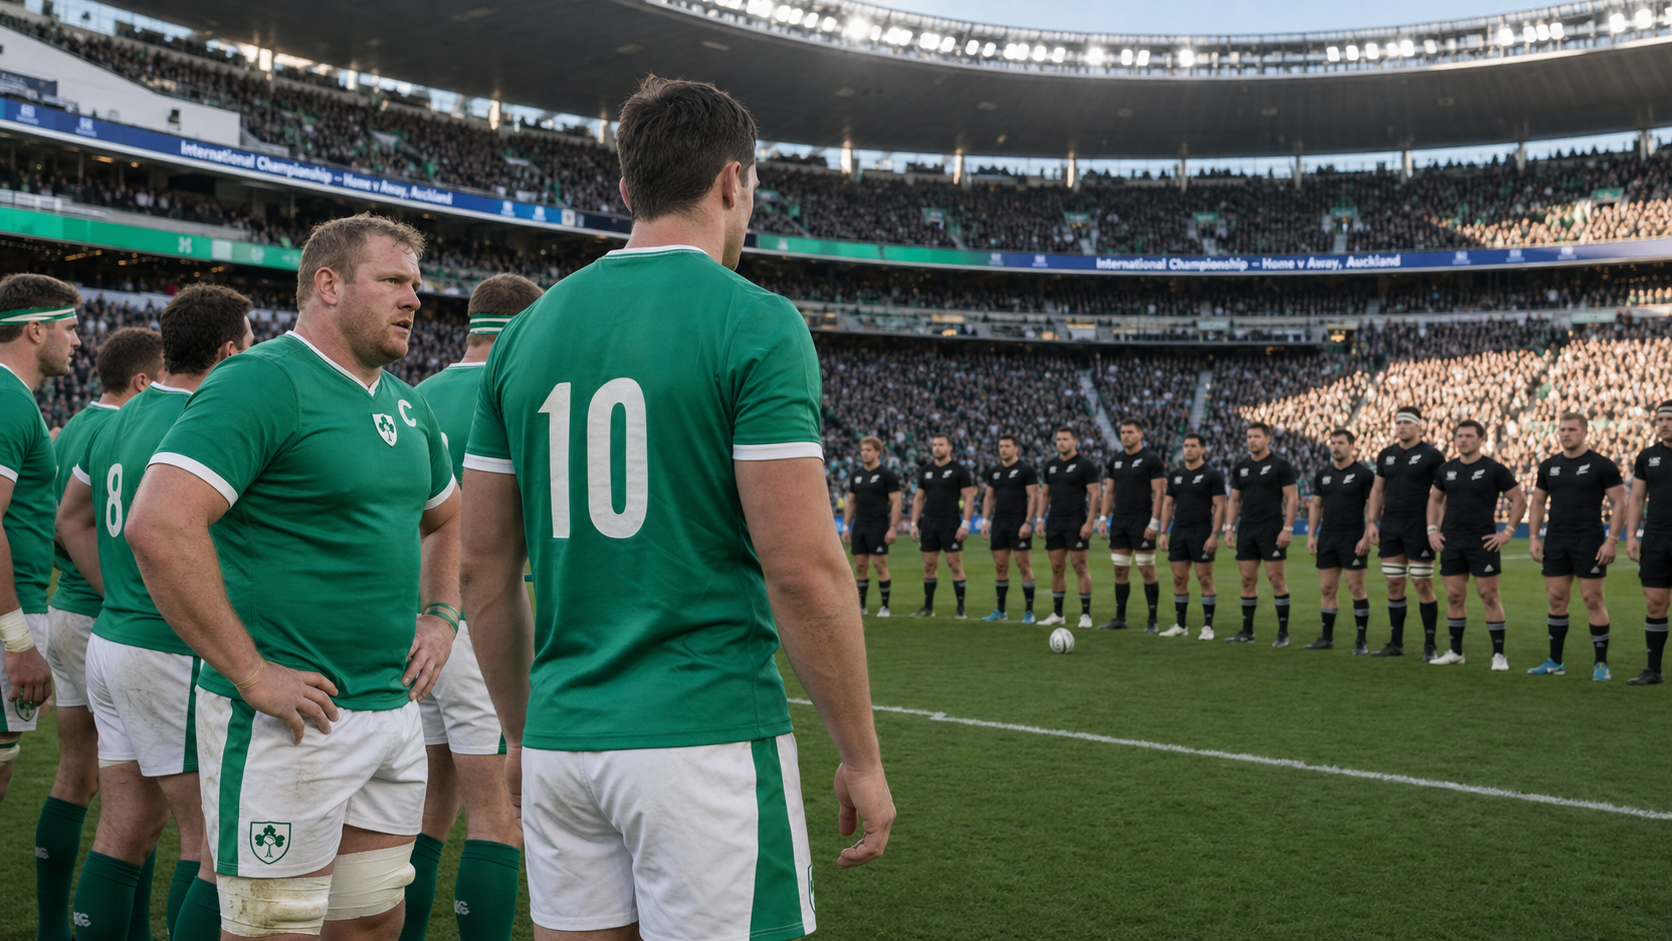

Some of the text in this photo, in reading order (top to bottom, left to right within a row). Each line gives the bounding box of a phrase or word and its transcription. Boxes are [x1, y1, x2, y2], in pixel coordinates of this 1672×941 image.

[181, 140, 255, 169] International
[256, 155, 333, 185] Championship
[410, 185, 453, 205] Auckland
[1096, 257, 1167, 270] International
[1168, 257, 1249, 272] Championship
[1262, 257, 1295, 270] Home
[1297, 259, 1305, 269] v
[1306, 256, 1343, 271] Away,
[1346, 253, 1401, 269] Auckland
[397, 399, 417, 428] C
[537, 377, 648, 539] 10
[106, 463, 123, 538] 8
